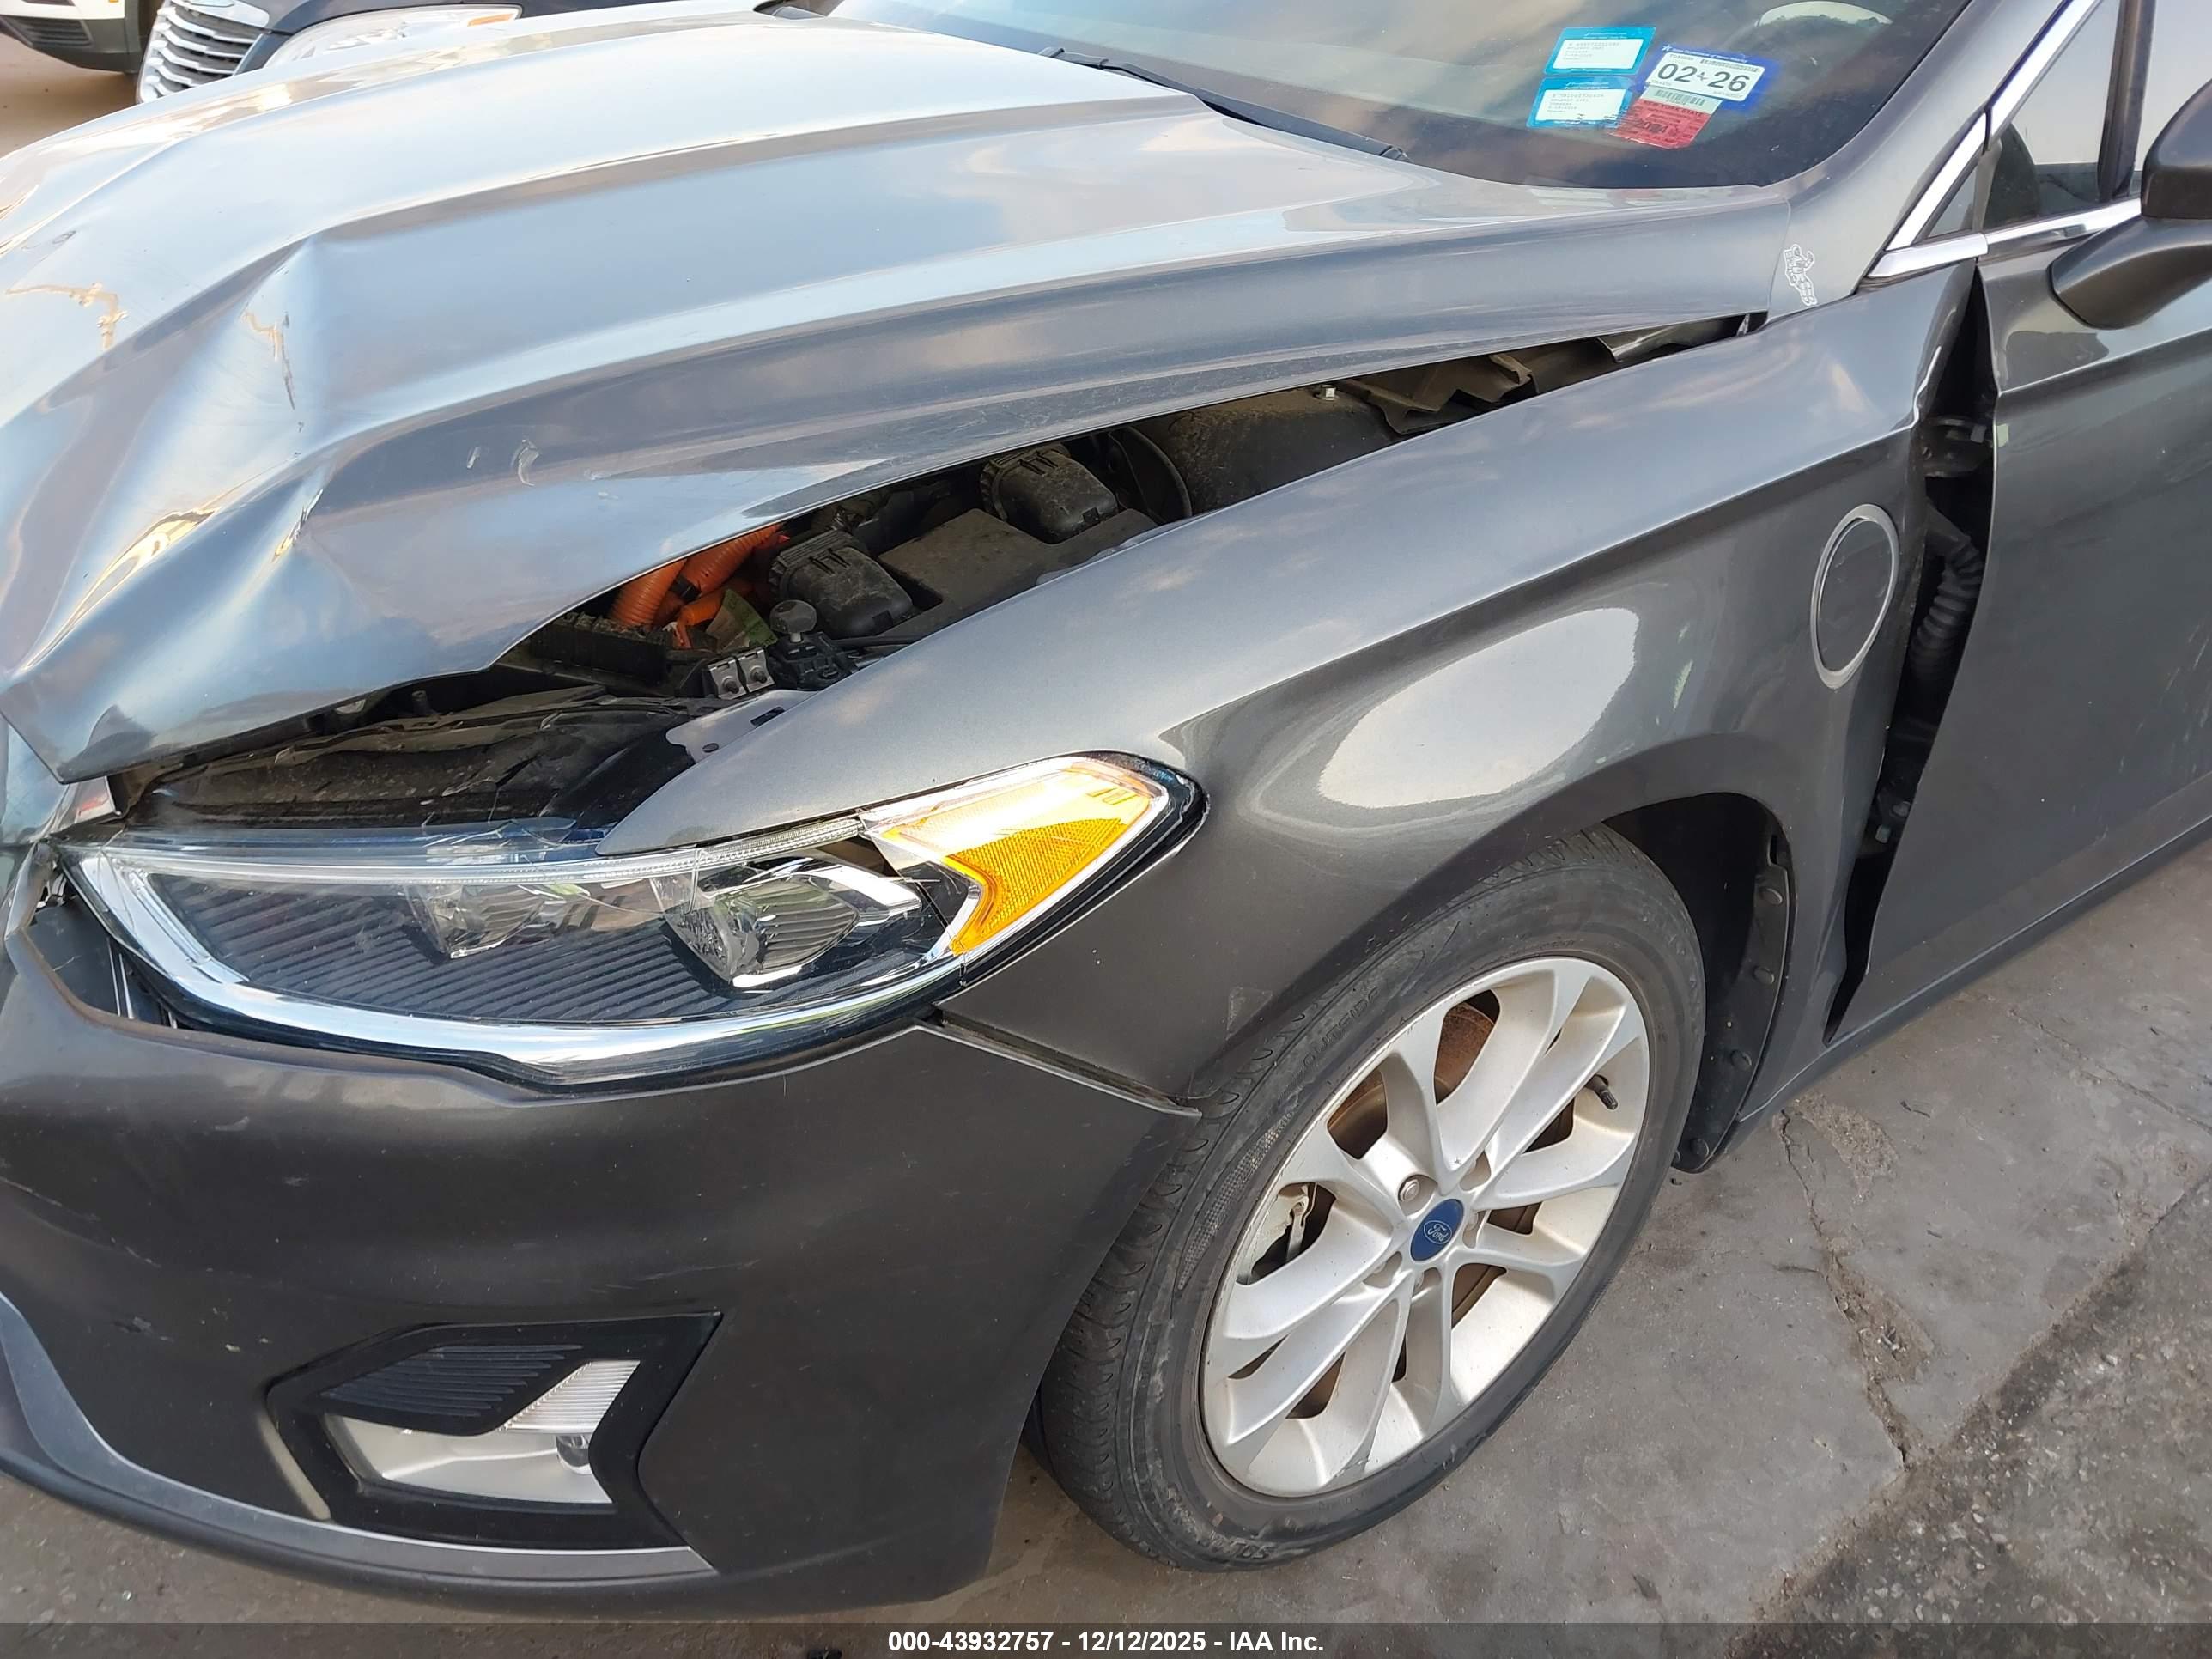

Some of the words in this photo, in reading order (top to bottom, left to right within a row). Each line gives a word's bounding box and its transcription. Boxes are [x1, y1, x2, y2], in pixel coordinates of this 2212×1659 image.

[1657, 63, 1698, 83] 02
[1707, 71, 1750, 92] 26
[1681, 106, 1704, 117] STATE
[1427, 1223, 1449, 1242] Ford
